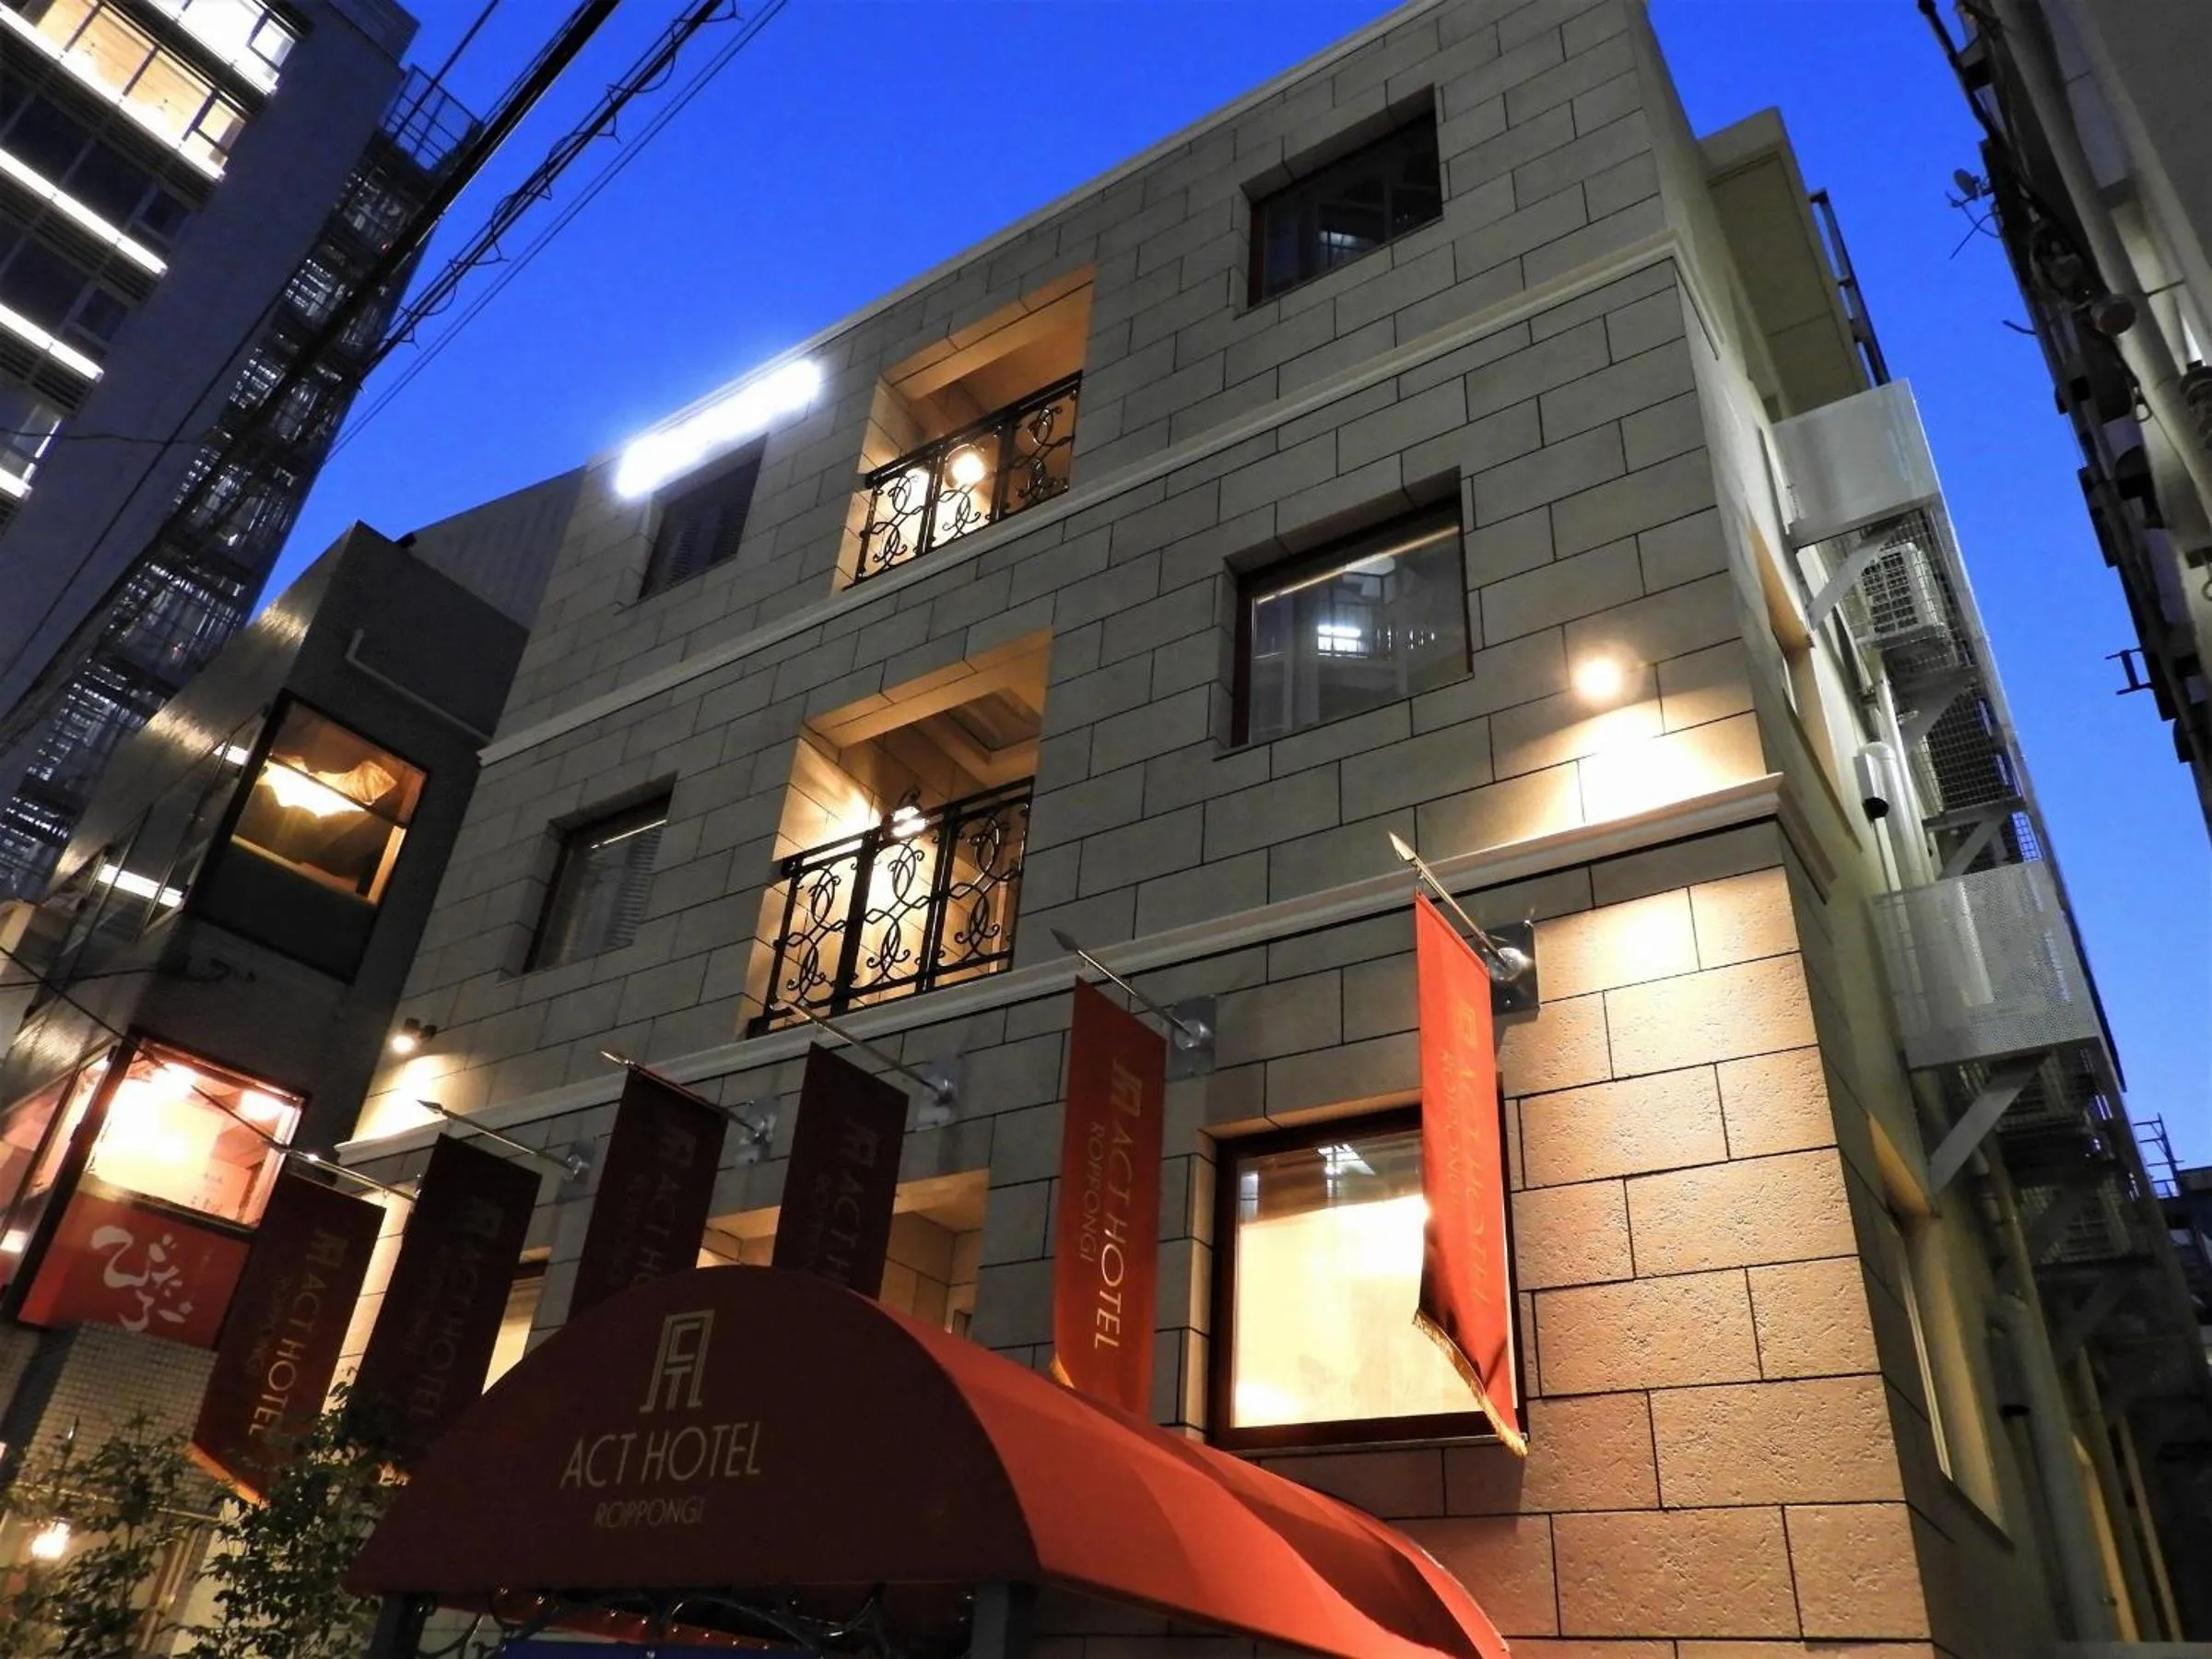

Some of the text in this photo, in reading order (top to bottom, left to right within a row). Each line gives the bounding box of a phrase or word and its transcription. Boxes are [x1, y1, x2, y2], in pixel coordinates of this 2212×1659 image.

[1079, 1121, 1106, 1264] ROPPONGI
[1094, 1123, 1135, 1349] ACT HOTEL
[248, 1273, 329, 1437] ACT HOTEL
[559, 1421, 762, 1489] ACT HOTEL
[594, 1495, 707, 1528] ROPPONGI
